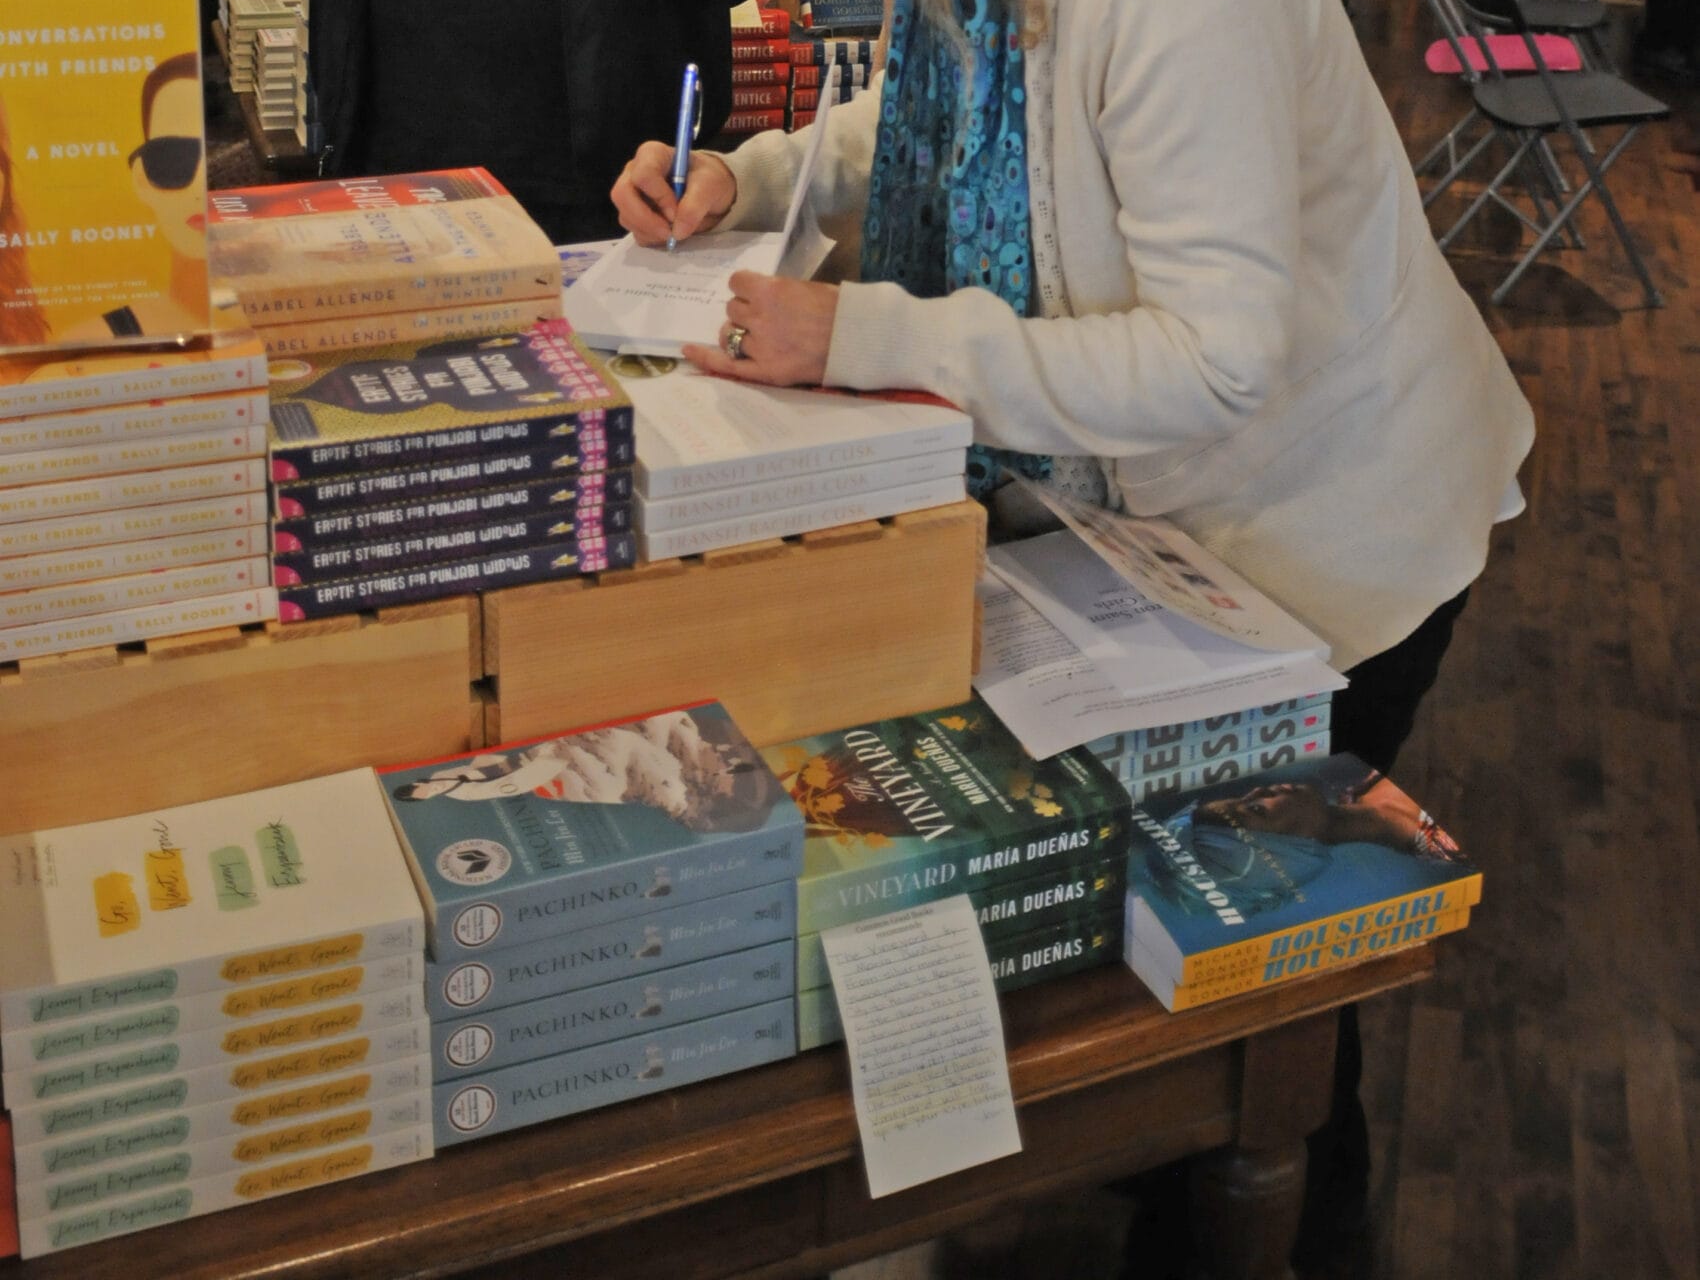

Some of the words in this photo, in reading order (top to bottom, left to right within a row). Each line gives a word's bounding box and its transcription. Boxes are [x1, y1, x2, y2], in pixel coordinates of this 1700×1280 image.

[0, 23, 165, 45] NVERSATIONS
[61, 55, 156, 75] FRIENDS
[26, 146, 39, 160] A
[51, 142, 119, 158] NOVEL
[0, 231, 58, 248] SALLY
[71, 224, 157, 243] ROONEY
[412, 277, 426, 288] IN
[434, 274, 462, 286] THE
[471, 271, 517, 283] MIDST
[443, 287, 503, 300] WINTER
[242, 301, 304, 314] ISABEL
[316, 289, 396, 307] ALLENDE
[414, 315, 428, 328] IN
[436, 314, 464, 325] THE
[472, 309, 520, 322] MIDST
[319, 328, 398, 347] ALLENDE
[0, 393, 37, 407] WITH
[44, 387, 101, 402] FRIENDS
[124, 380, 163, 393] SALLY
[170, 372, 226, 386] ROONEY
[312, 446, 349, 463] EROTIC
[355, 439, 401, 458] STORIES
[405, 437, 423, 450] FOR
[427, 430, 476, 448] PUNJABI
[481, 423, 528, 442] WIDOWS
[317, 484, 356, 500] EROTIC
[359, 475, 406, 494] STORIES
[410, 472, 427, 484] FOR
[431, 463, 480, 481] PUNJABI
[484, 455, 531, 474] WIDOWS
[672, 462, 746, 488] TRANSIT
[756, 450, 822, 477] RACHEL
[829, 444, 876, 463] CUSK
[314, 516, 353, 534] EROTIC
[357, 509, 403, 528] STORIES
[407, 507, 425, 519] FOR
[428, 498, 477, 516] PUNJABI
[481, 490, 529, 509] WIDOWS
[314, 551, 351, 568] EROTIC
[356, 543, 402, 562] STORIES
[406, 540, 423, 553] FOR
[427, 531, 476, 549] PUNJABI
[480, 523, 527, 542] WIDOWS
[317, 585, 355, 603] EROTIC
[359, 576, 405, 596] STORIES
[409, 572, 426, 585] FOR
[430, 563, 479, 583] PUNJABI
[483, 555, 530, 575] WIDOWS
[14, 636, 51, 648] WITH
[57, 625, 114, 641] FRIENDS
[135, 615, 174, 629] SALLY
[181, 606, 235, 621] ROONEY
[844, 730, 954, 842] VINEYARD
[219, 861, 257, 898] Jenny
[838, 862, 956, 907] VINEYARD
[968, 843, 1020, 875] MARÍA
[1026, 829, 1090, 860] DUEÑAS
[517, 881, 638, 922] PACHINKO
[679, 864, 705, 882] Min
[706, 861, 725, 876] Jin
[727, 856, 746, 872] Lee
[974, 899, 1017, 924] ARÍA
[1023, 881, 1086, 913] DUEÑAS
[1269, 891, 1450, 959] HOUSEGIRL
[508, 941, 629, 983] PACHINKO
[1022, 938, 1083, 971] DUEÑAS
[1262, 916, 1442, 982] HOUSEGIRL
[509, 1002, 629, 1043] PACHINKO
[511, 1063, 631, 1106] PACHINKO
[671, 1046, 696, 1062] Min
[698, 1041, 716, 1057] Jin
[717, 1036, 738, 1051] Lee
